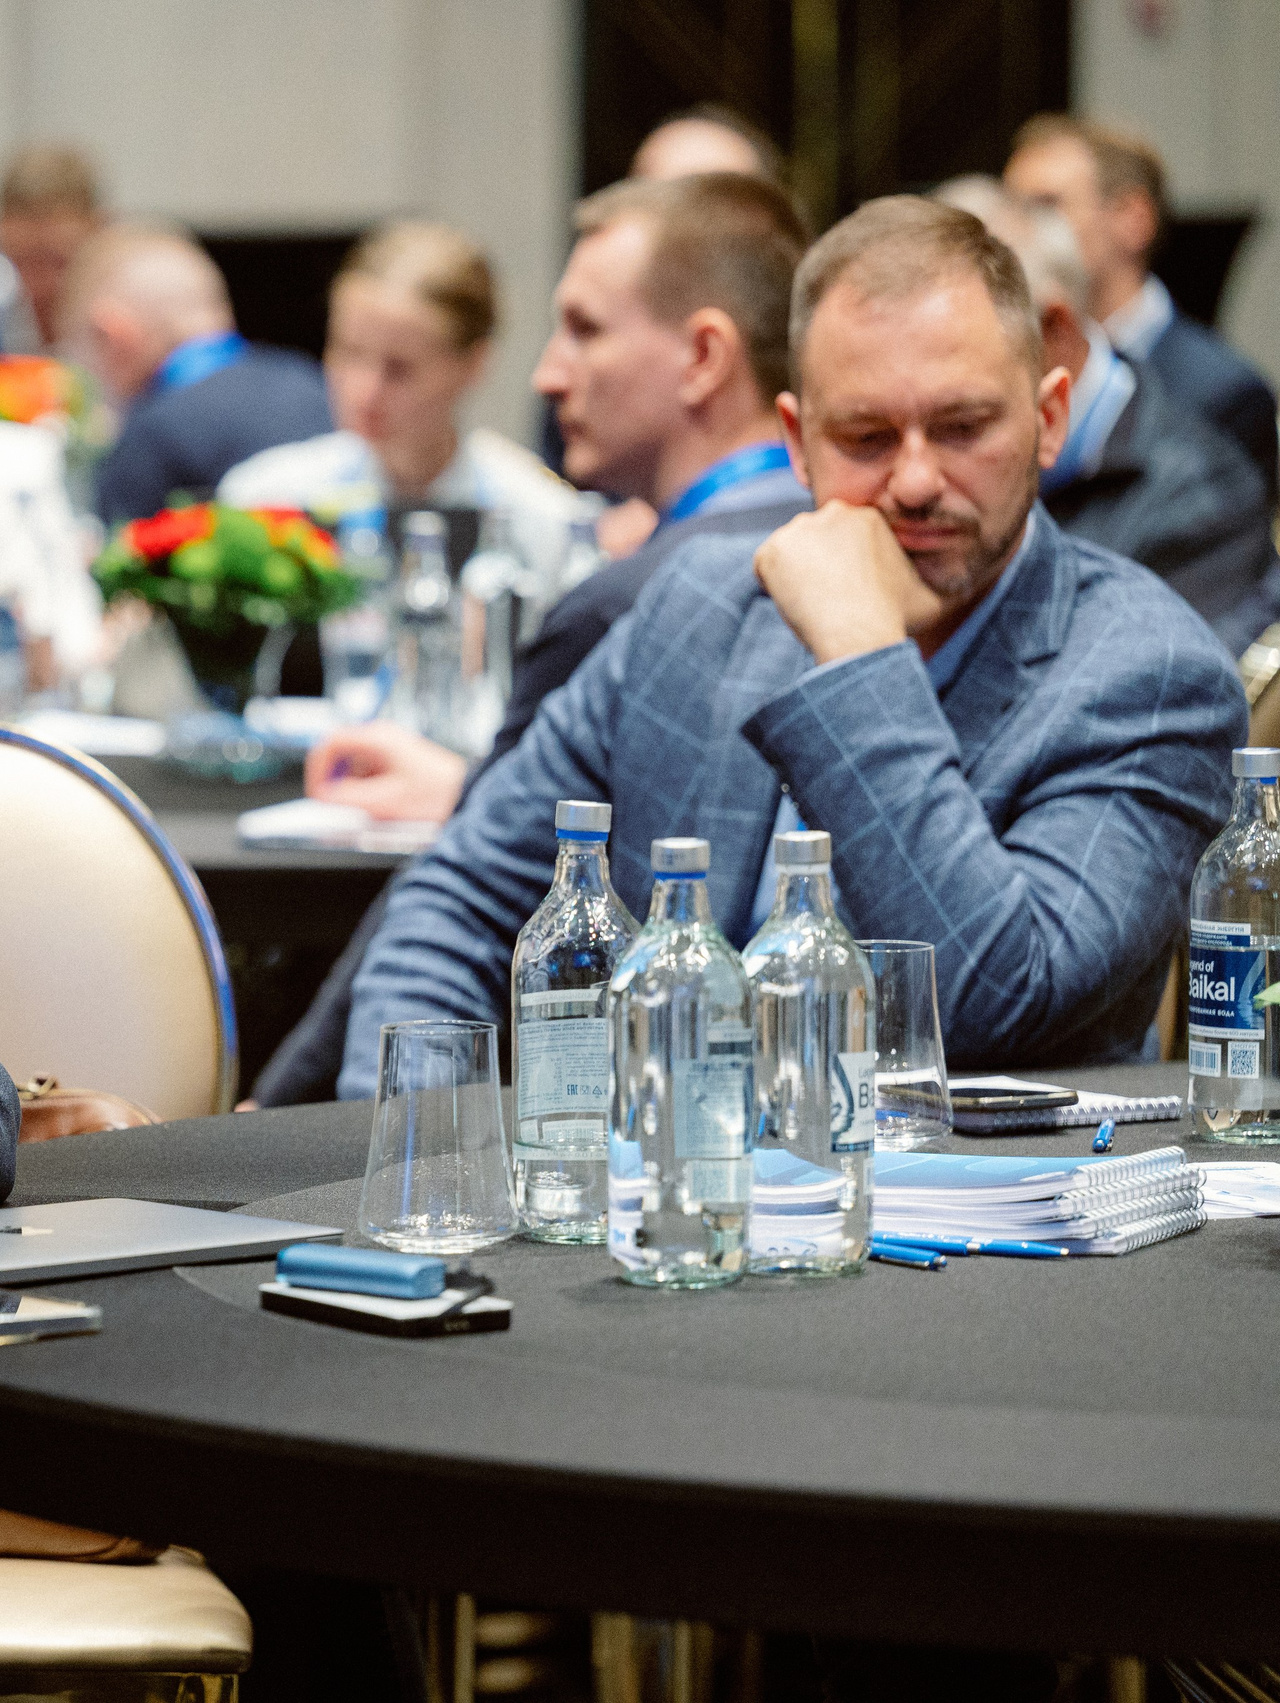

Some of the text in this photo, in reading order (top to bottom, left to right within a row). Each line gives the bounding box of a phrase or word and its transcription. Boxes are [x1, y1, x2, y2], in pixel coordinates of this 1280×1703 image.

[1190, 960, 1215, 973] gend of
[1217, 1009, 1235, 1018] ВОДА
